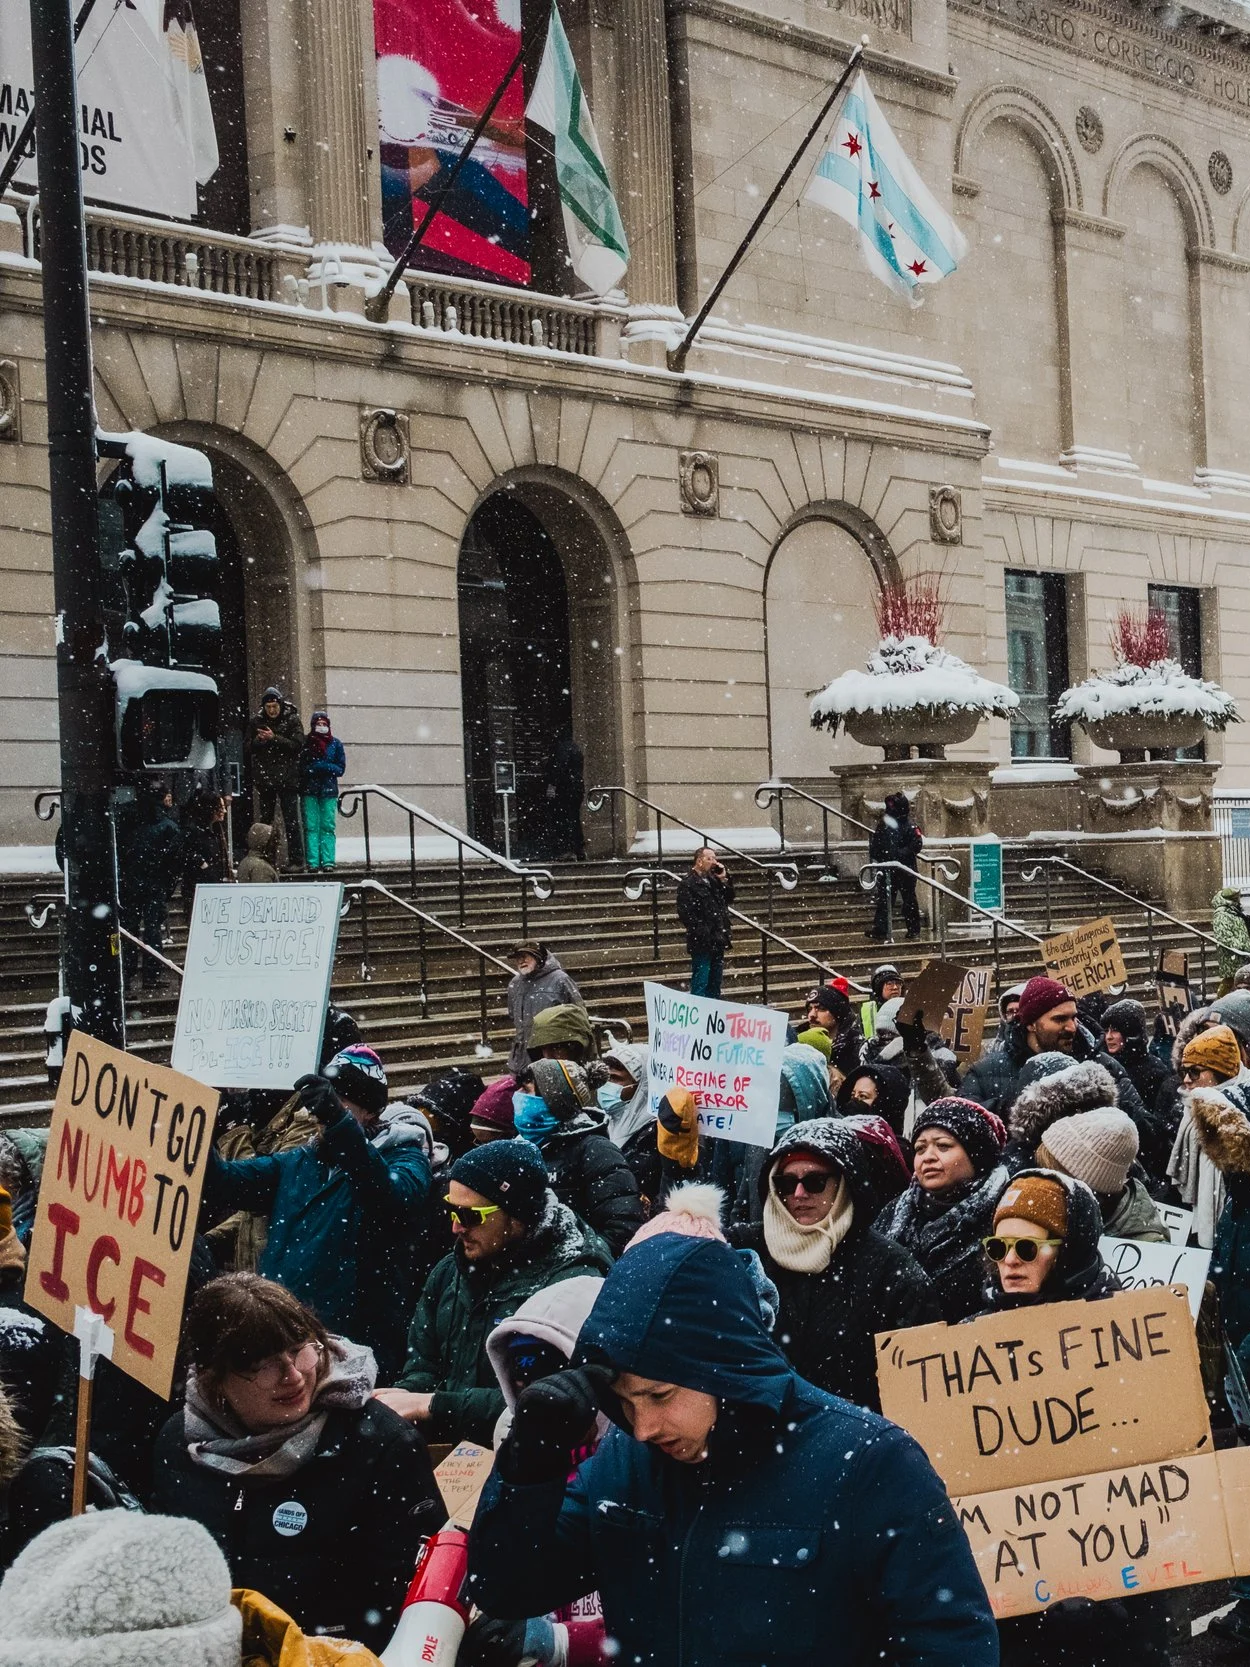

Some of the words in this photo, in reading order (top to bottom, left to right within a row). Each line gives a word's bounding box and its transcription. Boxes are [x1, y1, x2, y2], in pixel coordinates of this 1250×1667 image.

[1094, 31, 1195, 86] CORREGGIO
[200, 896, 232, 924] WE
[239, 896, 322, 925] DEMAND
[204, 925, 326, 970] JUSTICE!
[1046, 944, 1060, 957] the
[1075, 923, 1110, 949] dangerous
[1060, 950, 1092, 970] minority
[1092, 946, 1100, 958] is
[1083, 959, 1117, 988] RICH
[185, 998, 216, 1034] NO
[268, 998, 317, 1034] SECRET
[654, 993, 667, 1024] NO
[667, 999, 700, 1029] LOGIC
[725, 1011, 772, 1042] TRUTH
[716, 1041, 765, 1067] FUTURE
[676, 1065, 727, 1090] REGIME
[733, 1076, 752, 1093] OF
[71, 1050, 169, 1148] DON'T
[166, 1101, 207, 1178] GO
[696, 1112, 734, 1131] AFE!
[56, 1118, 148, 1228] NUMB
[152, 1172, 191, 1253] TO
[39, 1202, 167, 1361] ICE
[1058, 1311, 1171, 1371] FINE
[1014, 1482, 1086, 1527] NOT
[1107, 1464, 1190, 1511] MAD
[274, 1520, 303, 1531] CHICAGO
[994, 1531, 1047, 1584] AT
[1120, 1560, 1202, 1590] EVIL
[421, 1635, 439, 1664] PYLE
